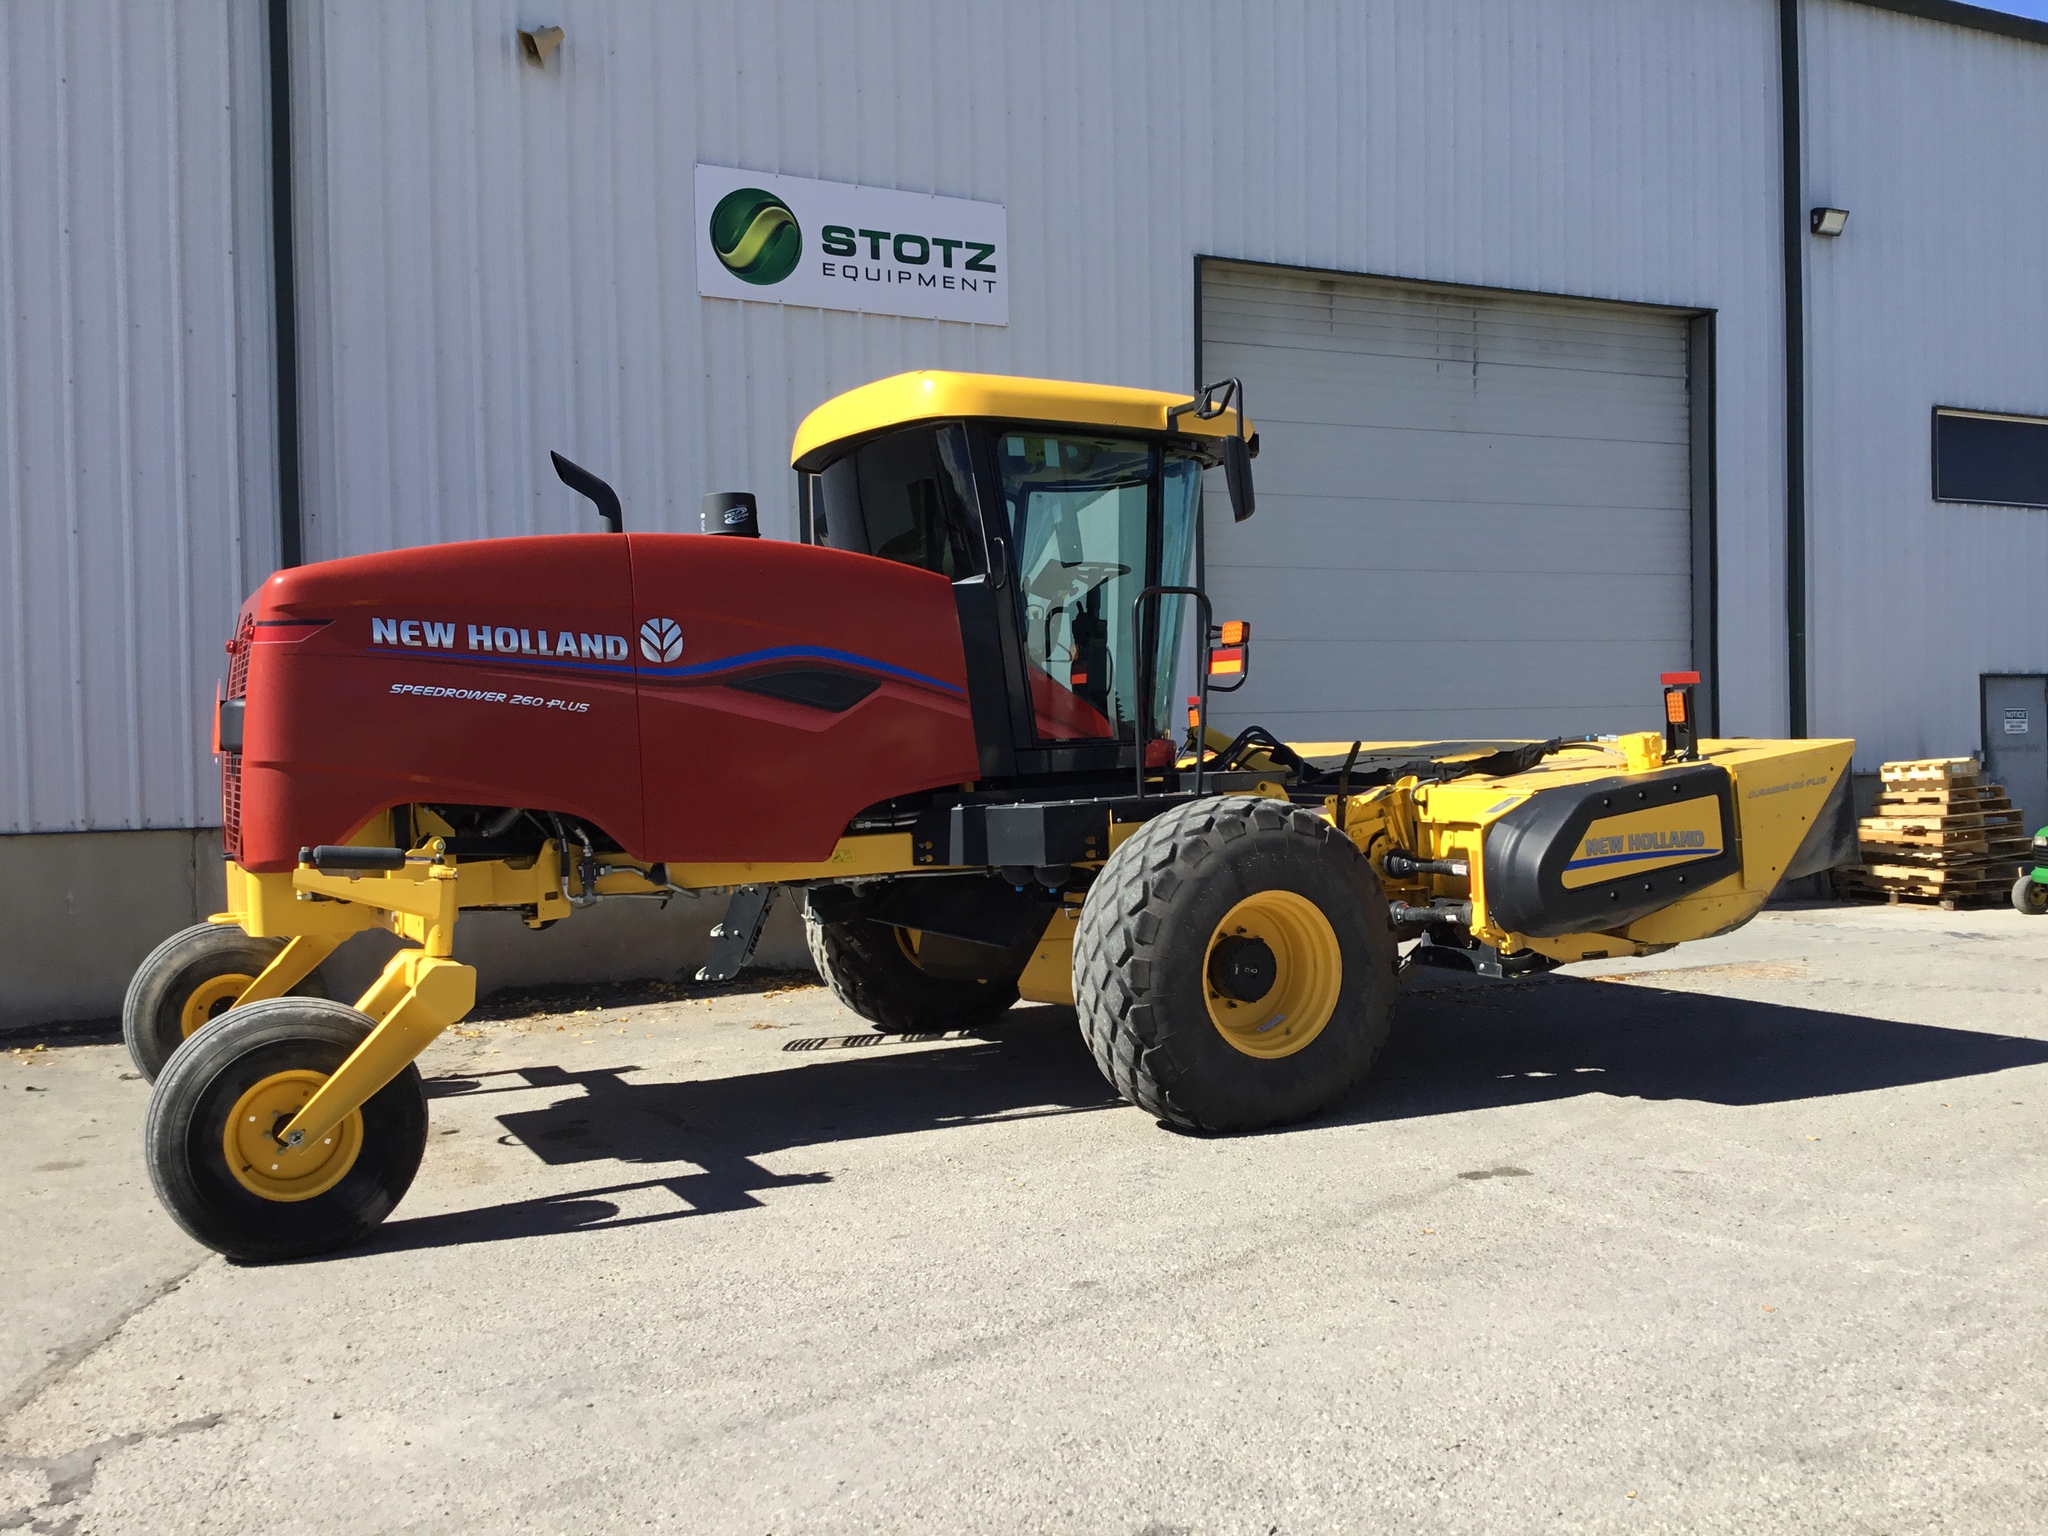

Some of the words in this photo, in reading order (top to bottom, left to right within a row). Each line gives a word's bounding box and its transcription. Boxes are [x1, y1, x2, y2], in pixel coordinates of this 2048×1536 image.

[821, 224, 997, 273] STOTZ
[822, 262, 997, 294] EQUIPMENT
[371, 617, 456, 649] NEW
[467, 624, 629, 661] HOLLAND
[389, 684, 507, 703] SPEEDROWER
[509, 694, 544, 707] 260
[2005, 710, 2026, 718] NOTICE
[1585, 834, 1624, 857] NEW
[1628, 829, 1705, 851] HOLLAND
